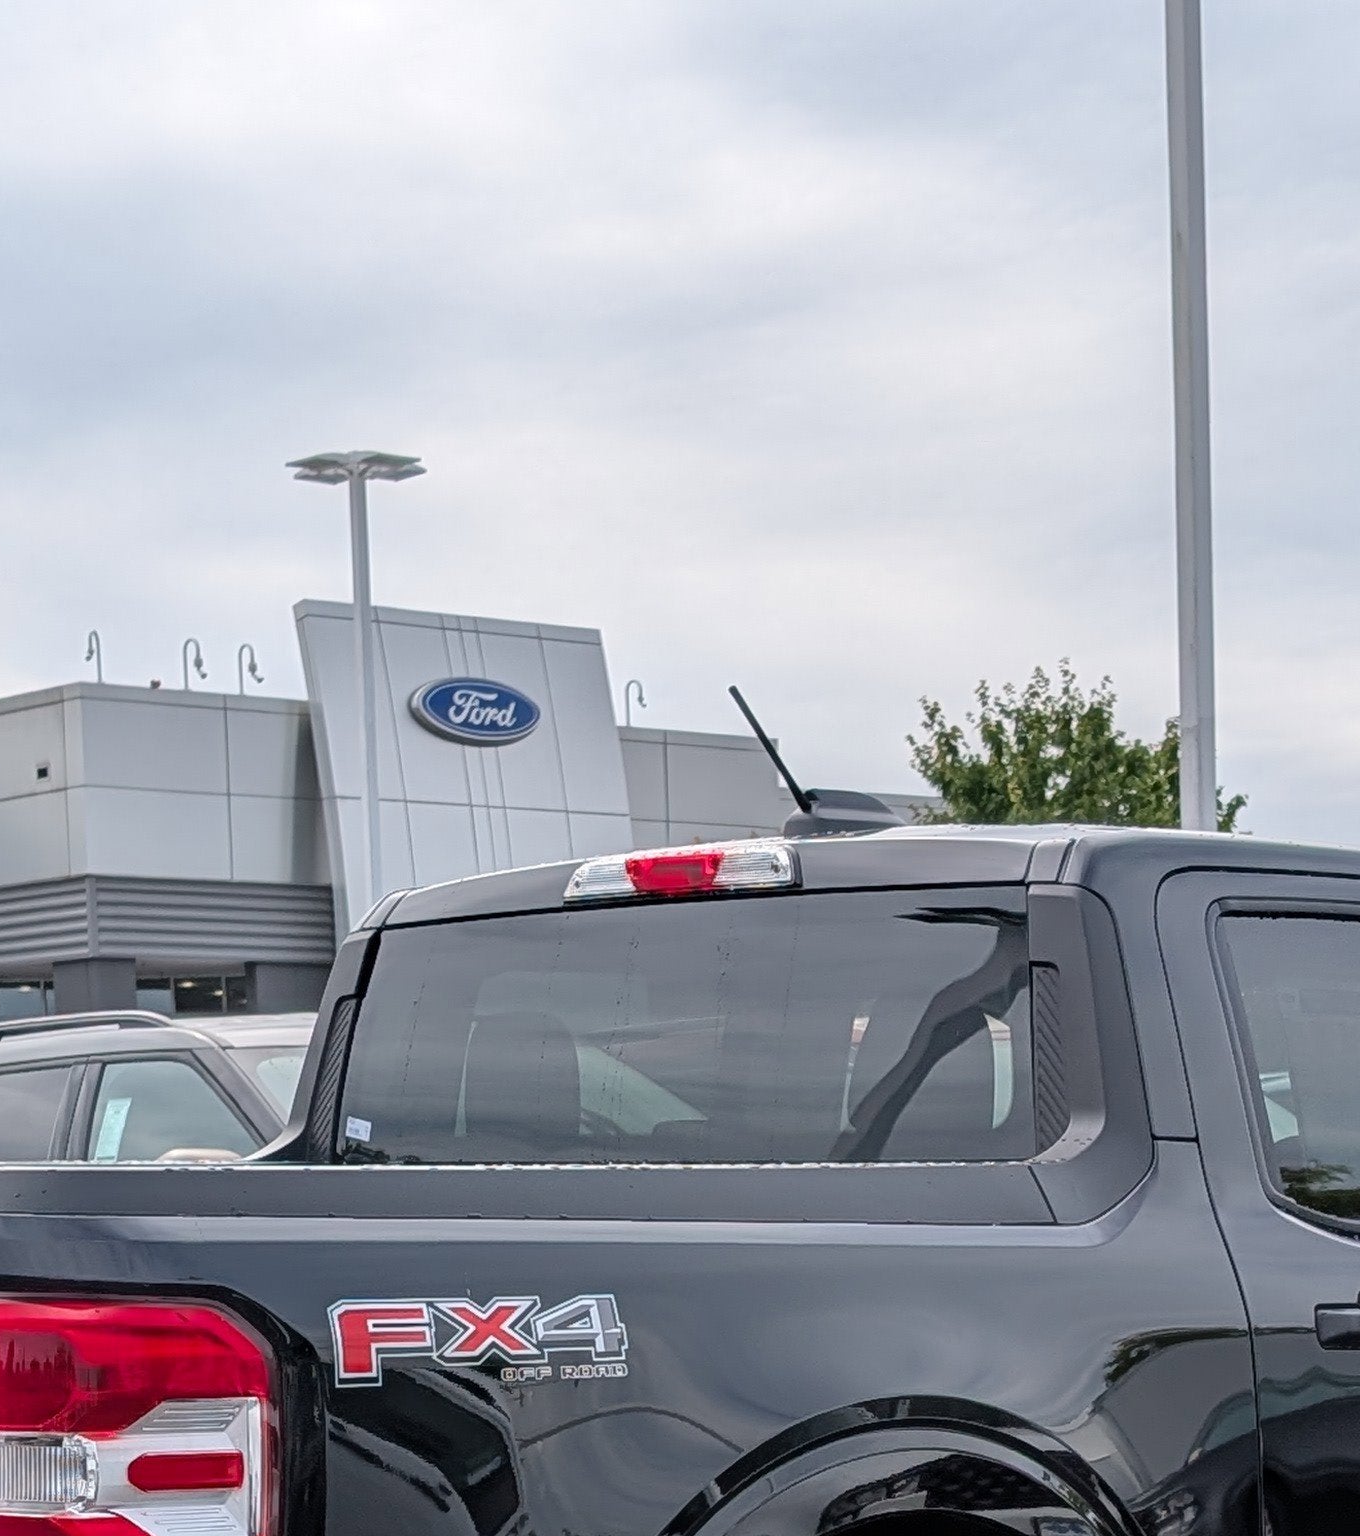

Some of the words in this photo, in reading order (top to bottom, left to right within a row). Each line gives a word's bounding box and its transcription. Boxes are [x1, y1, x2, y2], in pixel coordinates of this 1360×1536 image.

[448, 689, 518, 728] Ford
[327, 1294, 628, 1388] FX4
[501, 1366, 553, 1382] OFF
[560, 1363, 629, 1380] ROAD
